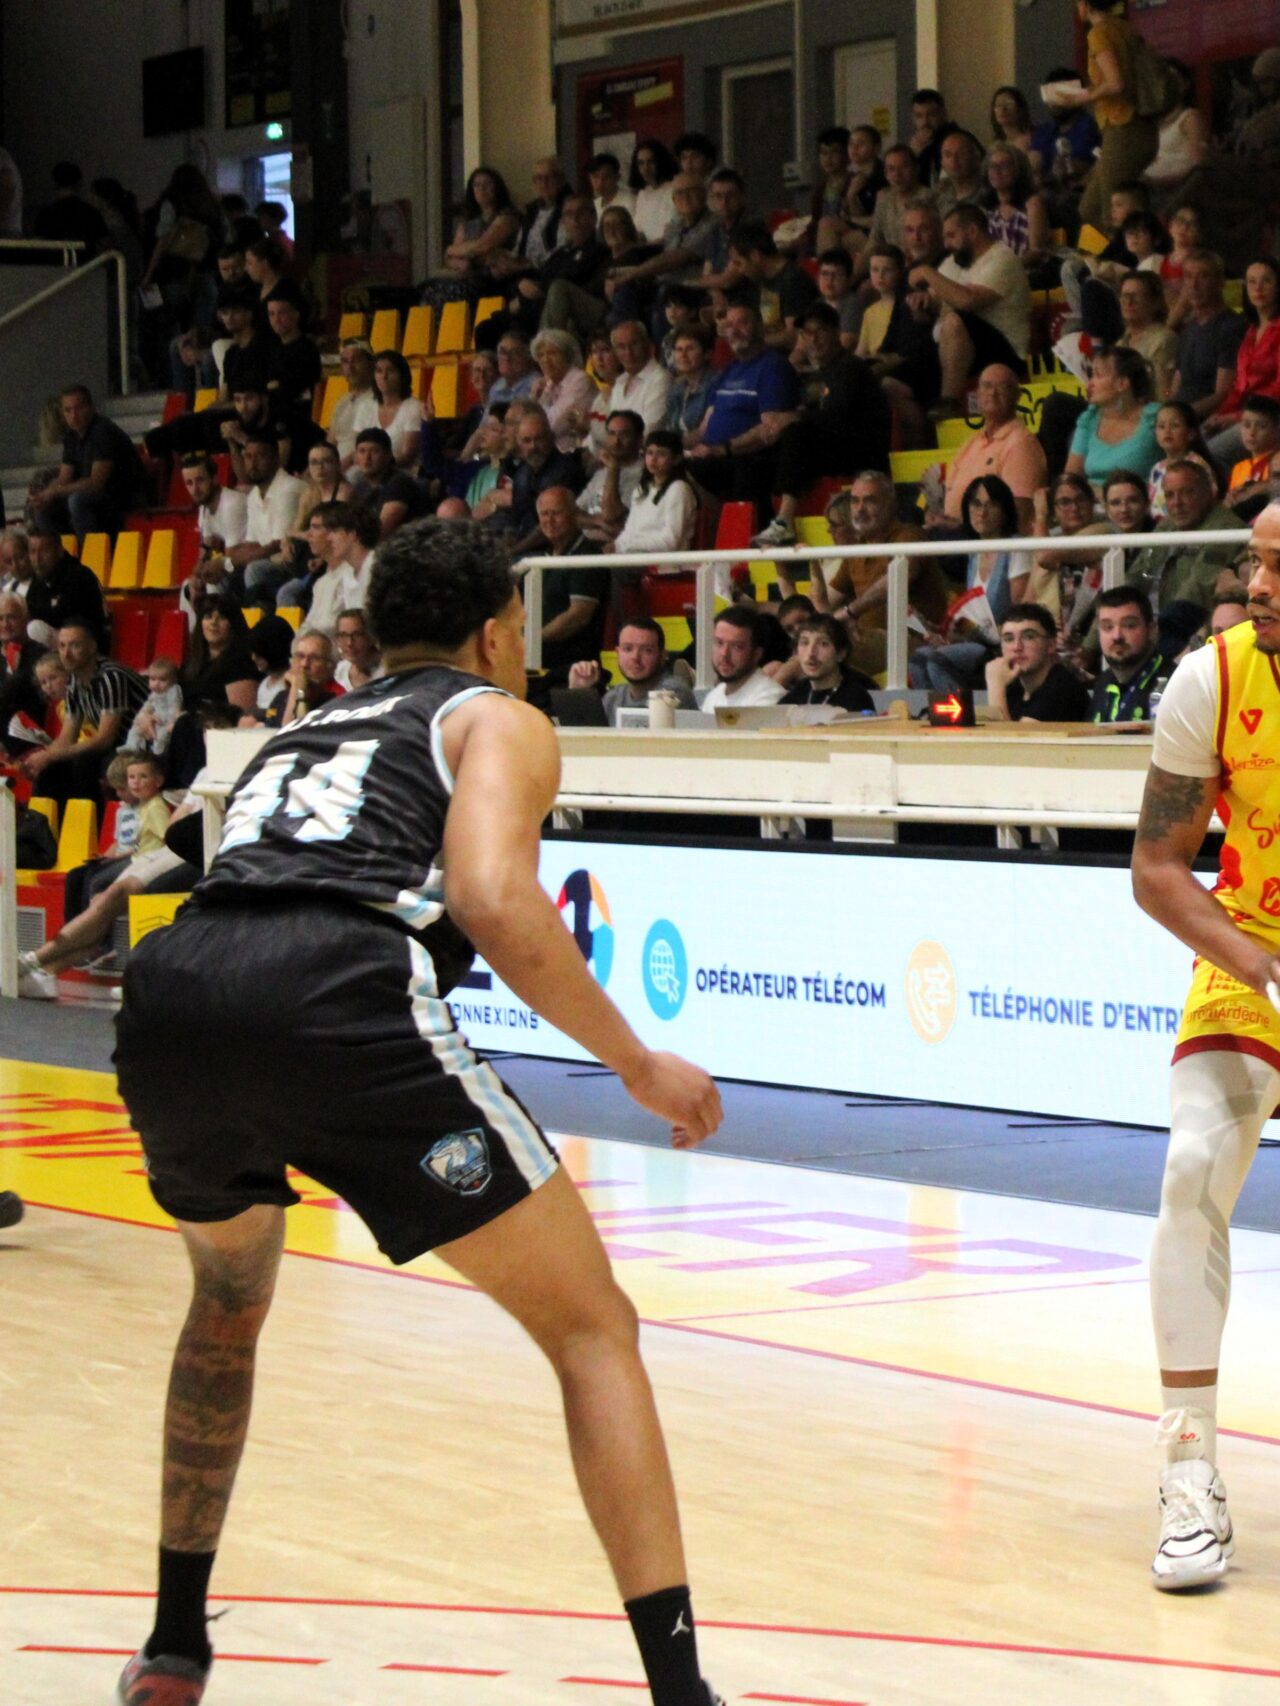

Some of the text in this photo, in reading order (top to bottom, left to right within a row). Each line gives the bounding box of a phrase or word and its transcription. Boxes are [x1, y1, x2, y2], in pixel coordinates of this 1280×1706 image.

[217, 740, 381, 855] 14
[696, 963, 887, 1008] OPÉRATEUR TÉLÉCOM
[453, 1002, 539, 1030] ONNEXIONS
[968, 985, 1184, 1034] TÉLÉPHONIE D'ENTR
